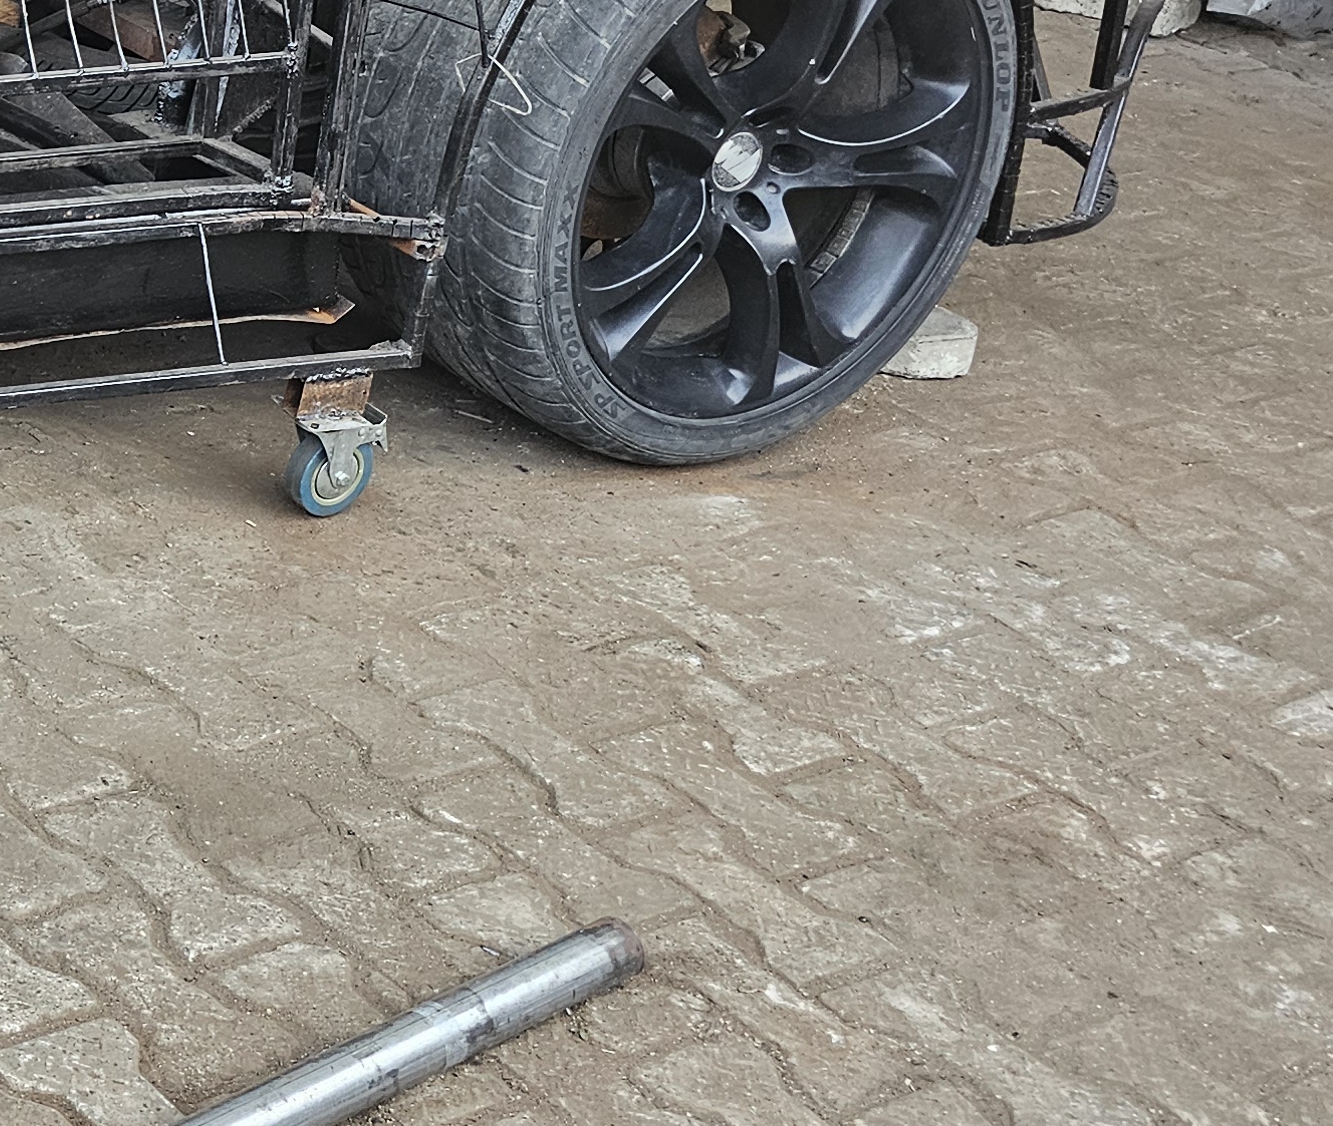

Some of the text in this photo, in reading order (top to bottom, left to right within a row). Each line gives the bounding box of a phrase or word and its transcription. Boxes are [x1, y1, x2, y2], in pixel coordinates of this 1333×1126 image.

[553, 183, 628, 420] SP SPORT MAXX
